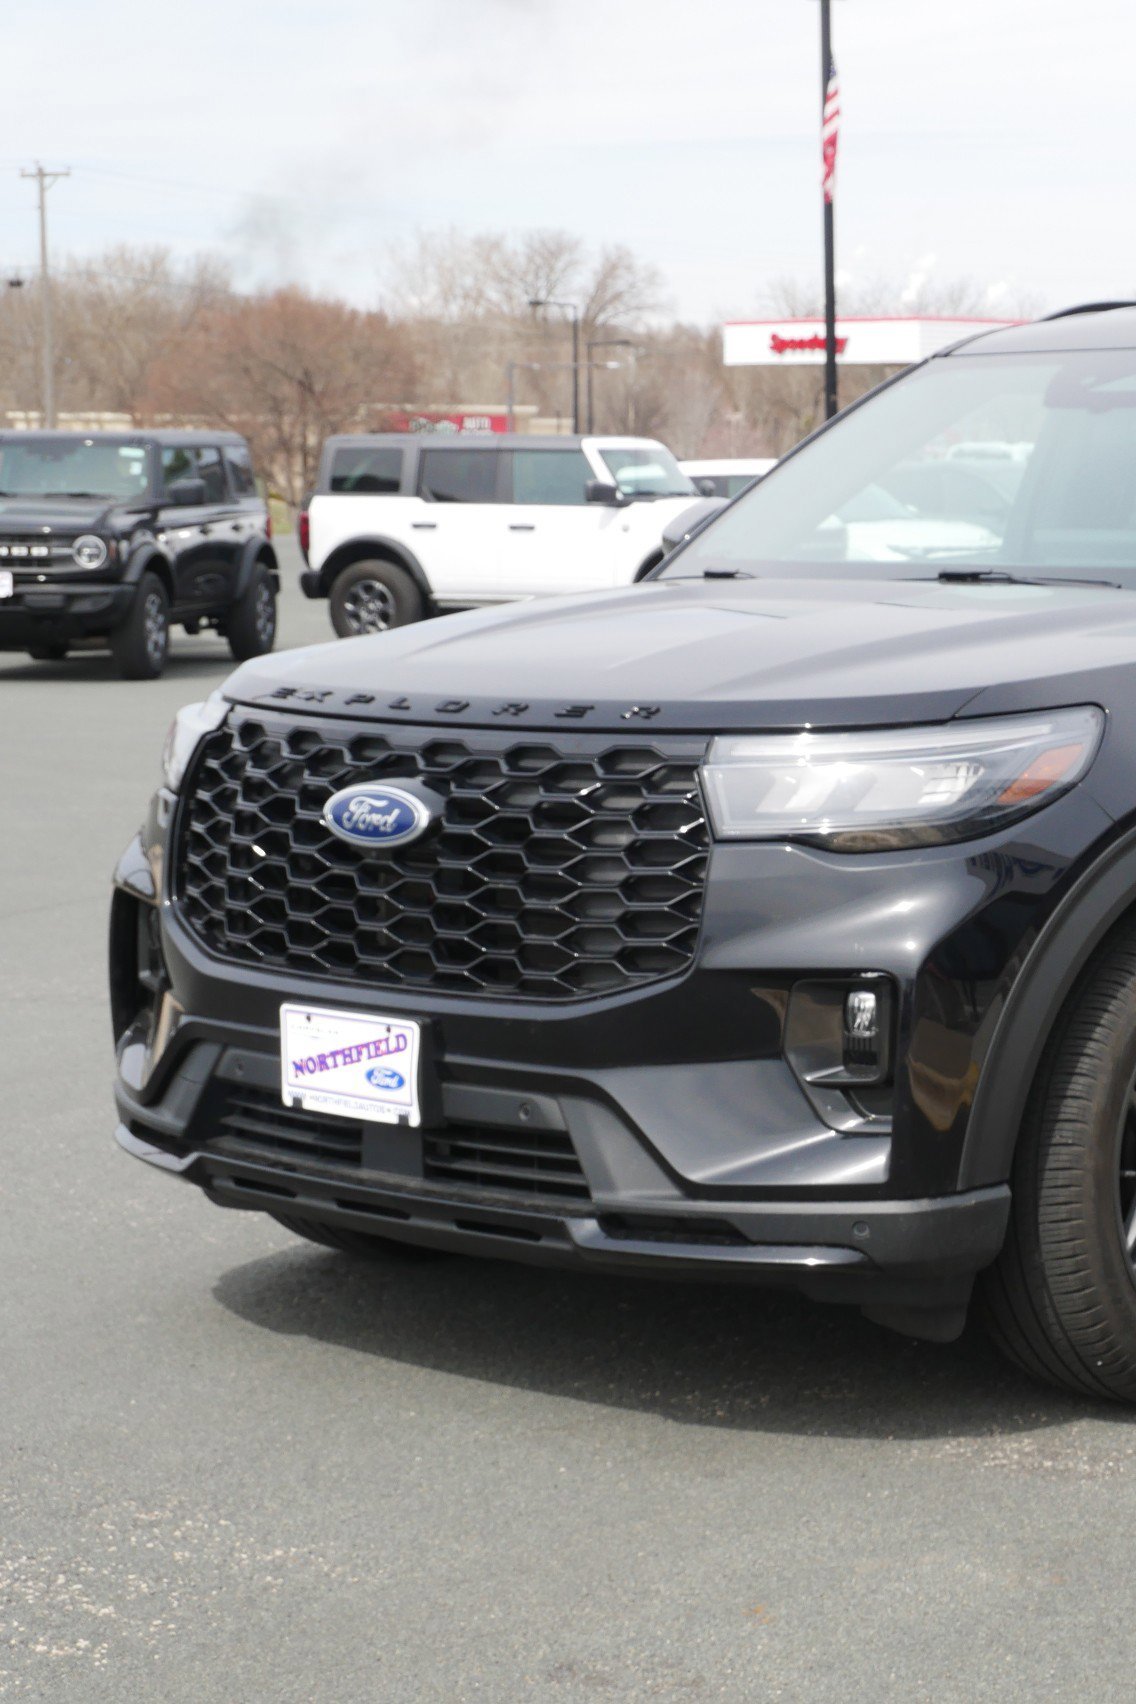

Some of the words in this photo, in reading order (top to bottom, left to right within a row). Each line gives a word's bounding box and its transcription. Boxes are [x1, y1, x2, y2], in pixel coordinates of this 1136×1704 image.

[770, 333, 848, 354] Speedwy
[271, 687, 661, 720] EXPLORER
[341, 796, 401, 833] Ford
[292, 1033, 408, 1078] NORTHFIELD
